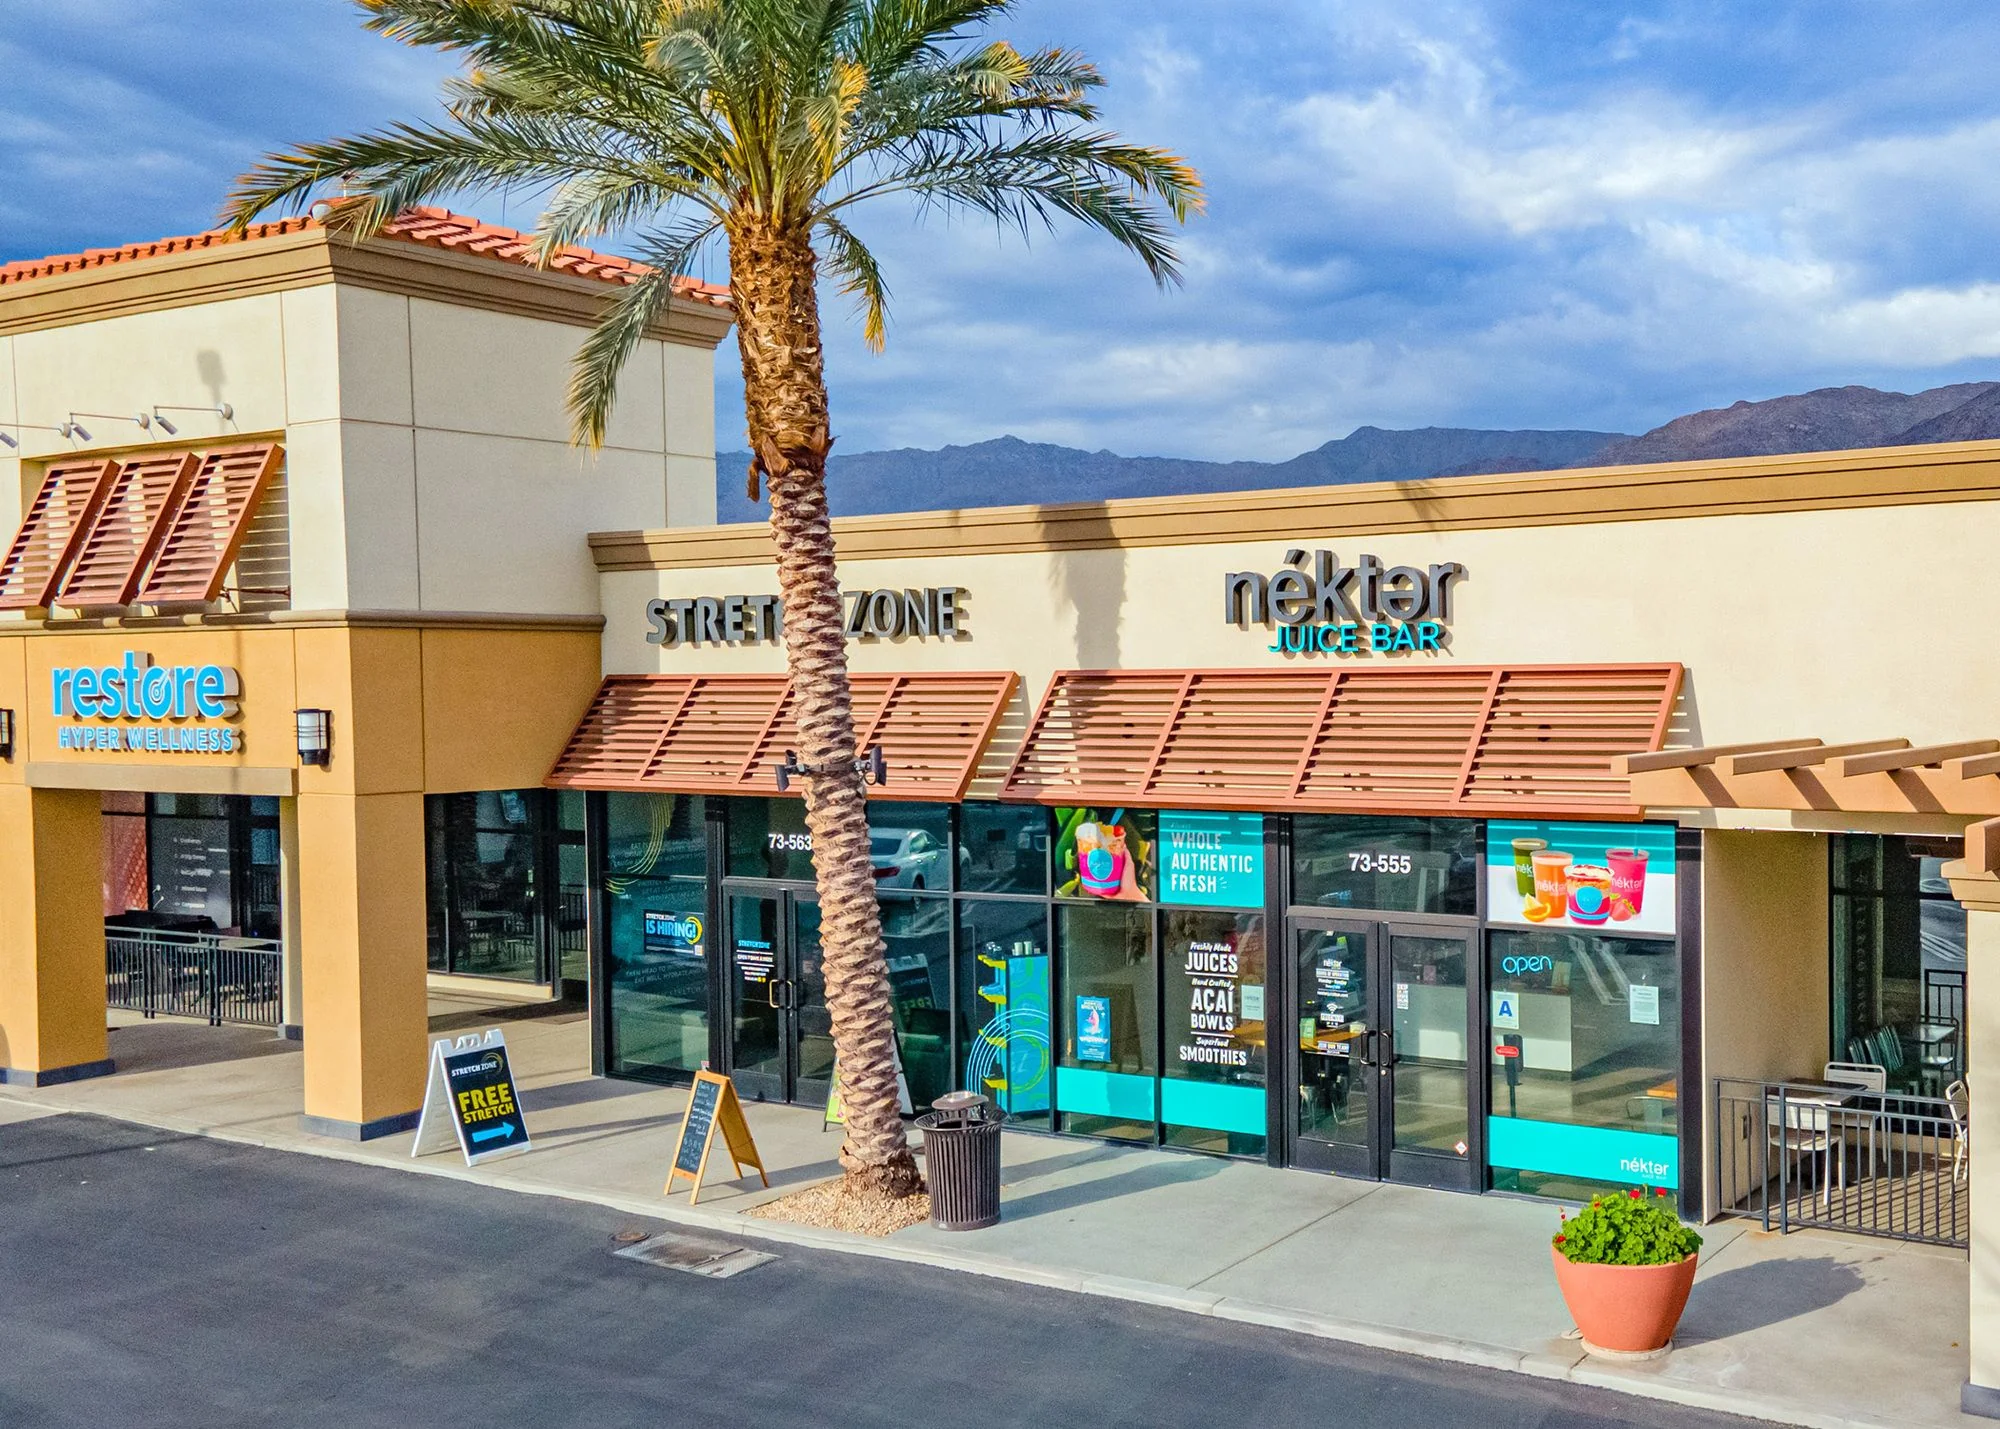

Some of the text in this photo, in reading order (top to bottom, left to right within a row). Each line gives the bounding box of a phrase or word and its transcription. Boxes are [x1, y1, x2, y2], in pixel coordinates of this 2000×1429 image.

[646, 587, 963, 645] STRET ZONE
[1268, 621, 1442, 654] JUICE BAR
[51, 650, 231, 719] restore
[58, 726, 234, 752] HYPER WELLNESS
[768, 833, 812, 851] 73-563
[1171, 831, 1222, 850] WHOLE
[1171, 852, 1253, 874] AUTHENTIC
[1349, 853, 1412, 874] 73-555
[1171, 873, 1217, 894] FRESH
[646, 920, 697, 939] IS HIRING!
[1190, 941, 1232, 953] Freshly Made
[1184, 951, 1239, 974] JUICES
[1502, 955, 1553, 977] open
[1191, 977, 1231, 988] Hand Crafted
[1190, 985, 1235, 1015] AÇAÍ
[1499, 1000, 1513, 1017] A
[1190, 1013, 1234, 1032] BOWLS
[1195, 1036, 1230, 1048] Superfood
[1179, 1045, 1248, 1067] SMOOTHIES
[451, 1064, 481, 1077] STRETCH
[481, 1060, 498, 1071] ZONE
[458, 1083, 513, 1113] FREE
[463, 1102, 516, 1125] STRETCH
